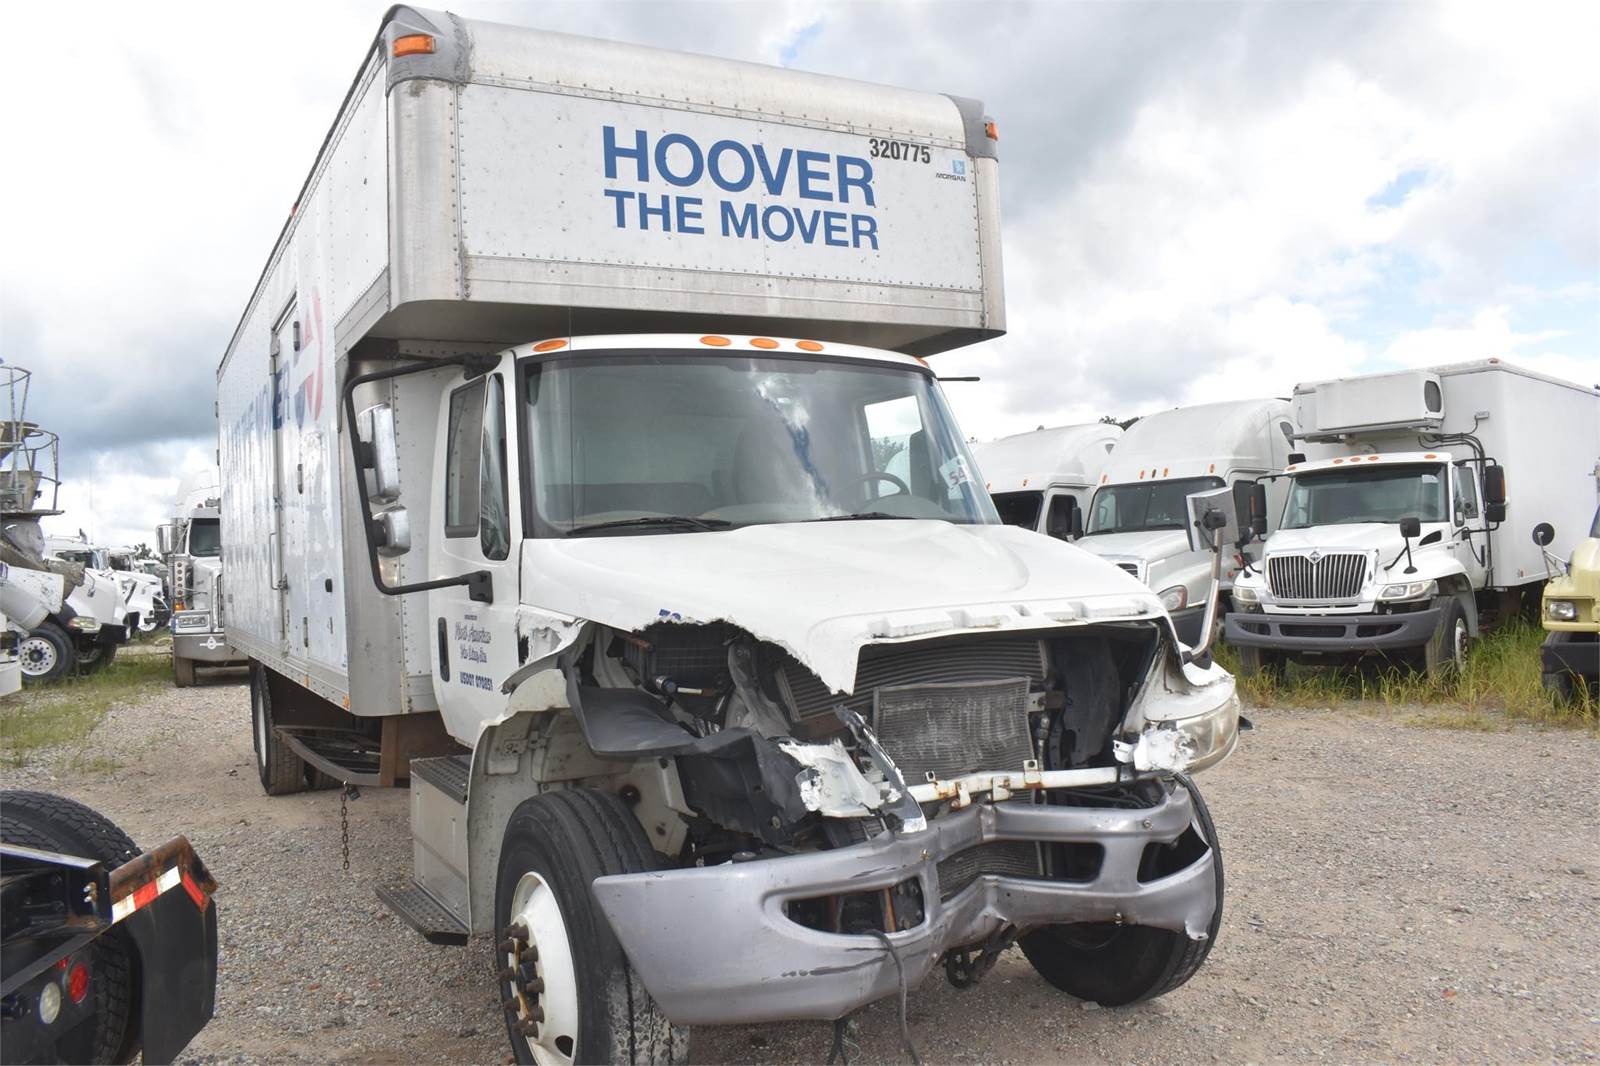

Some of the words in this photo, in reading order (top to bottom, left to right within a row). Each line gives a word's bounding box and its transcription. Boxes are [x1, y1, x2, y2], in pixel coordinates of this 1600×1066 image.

[602, 125, 876, 208] HOOVER
[869, 138, 931, 164] 320775
[935, 172, 966, 182] MORGAN
[604, 188, 705, 234] THE
[720, 200, 879, 250] MOVER
